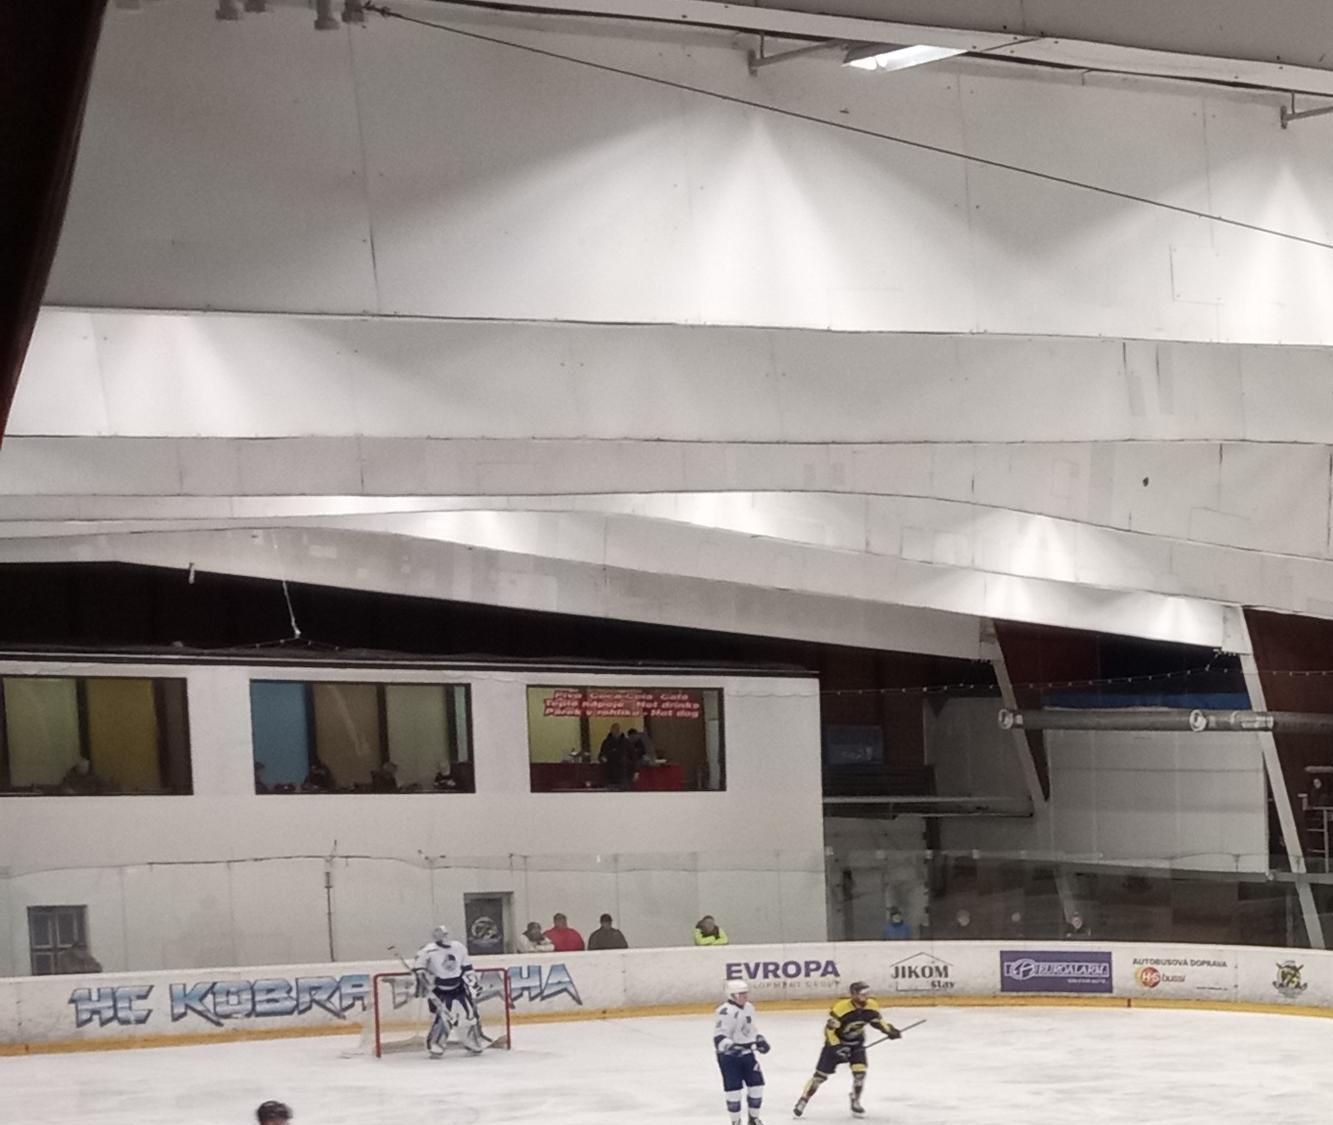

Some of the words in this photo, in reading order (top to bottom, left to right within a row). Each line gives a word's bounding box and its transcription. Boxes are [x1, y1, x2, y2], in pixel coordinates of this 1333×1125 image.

[726, 960, 840, 980] EVROPA
[891, 965, 949, 979] JIKOM
[169, 974, 372, 1027] KOBRA
[381, 964, 583, 1010] PAHA
